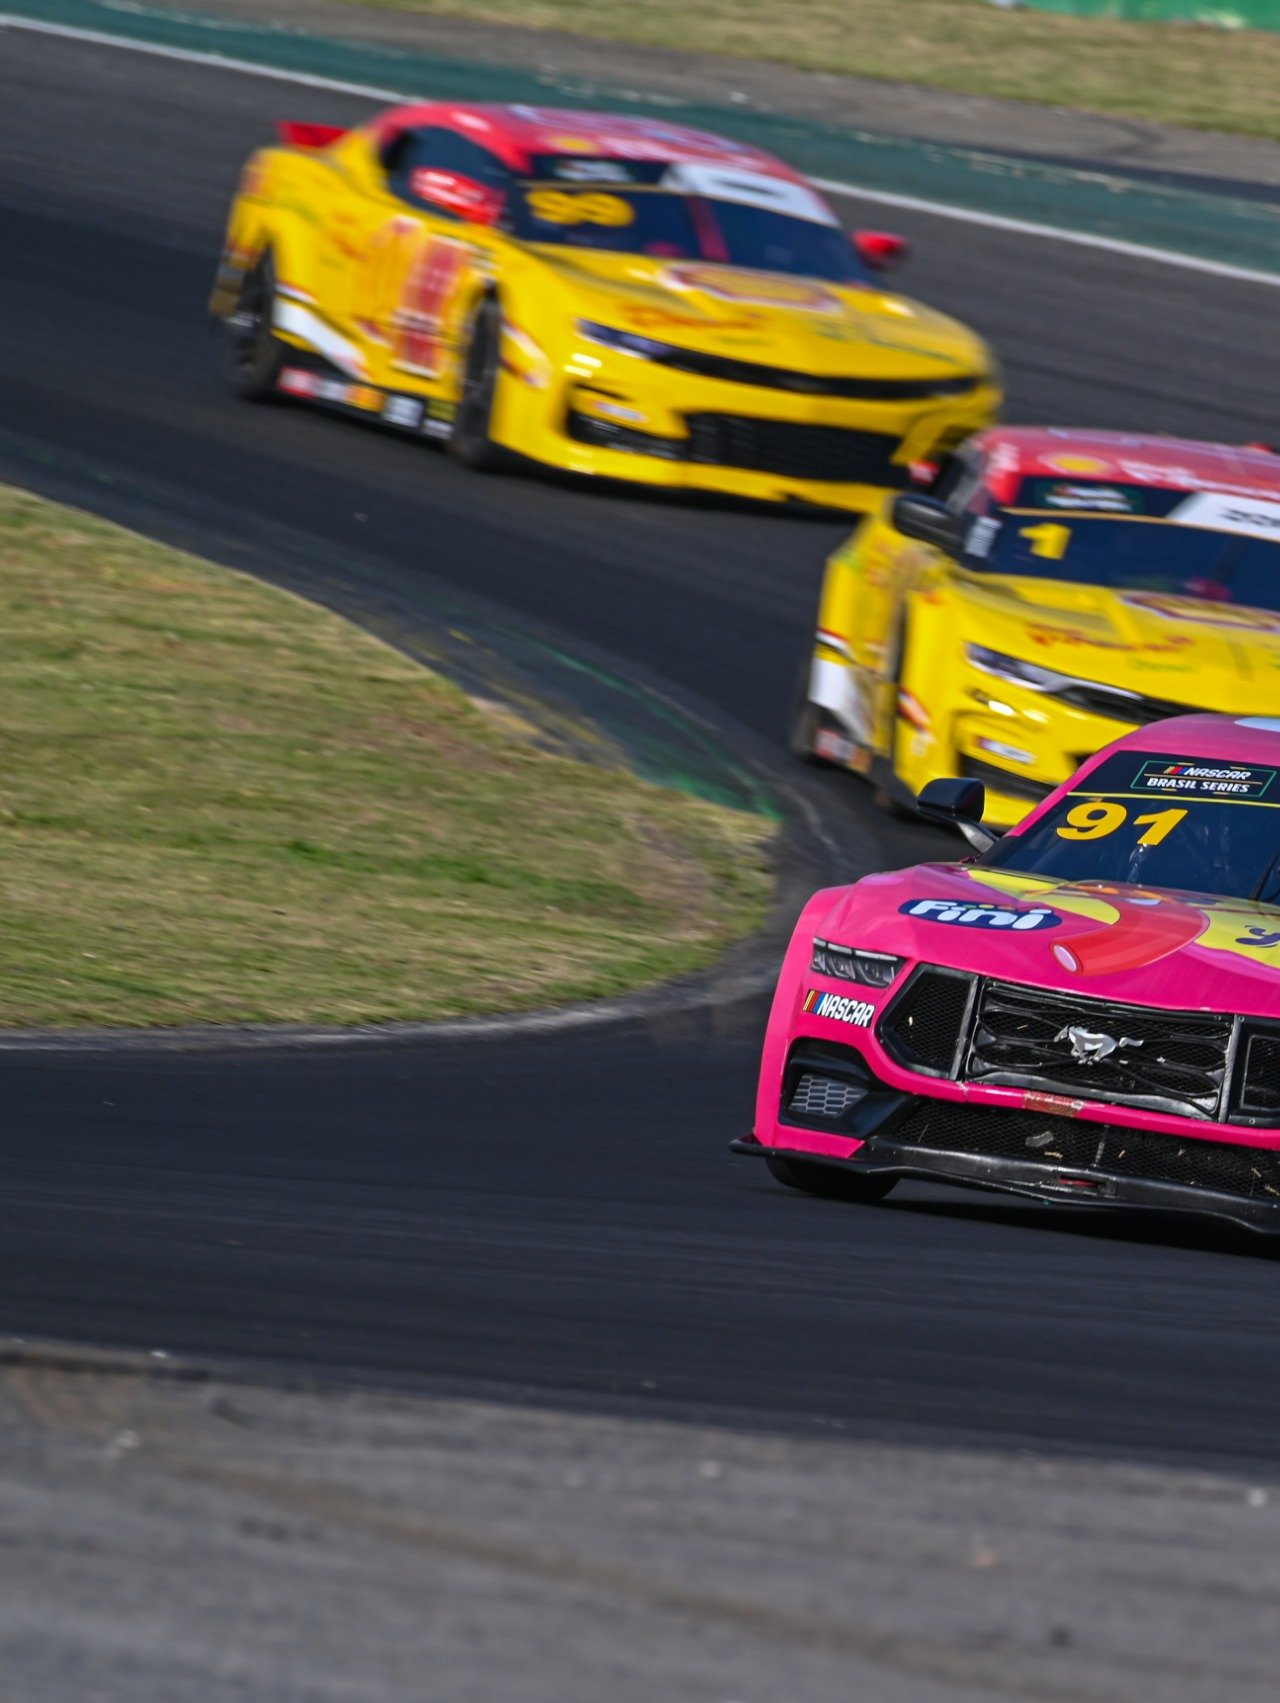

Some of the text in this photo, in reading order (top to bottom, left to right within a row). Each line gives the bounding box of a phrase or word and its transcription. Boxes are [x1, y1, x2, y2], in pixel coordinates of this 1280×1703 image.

[1019, 522, 1072, 560] 1
[1147, 777, 1250, 793] BRASIL SERIES
[1183, 766, 1251, 780] NASCAR
[1056, 802, 1188, 846] 91
[909, 899, 1052, 930] Fini
[817, 993, 875, 1028] NASCAR
